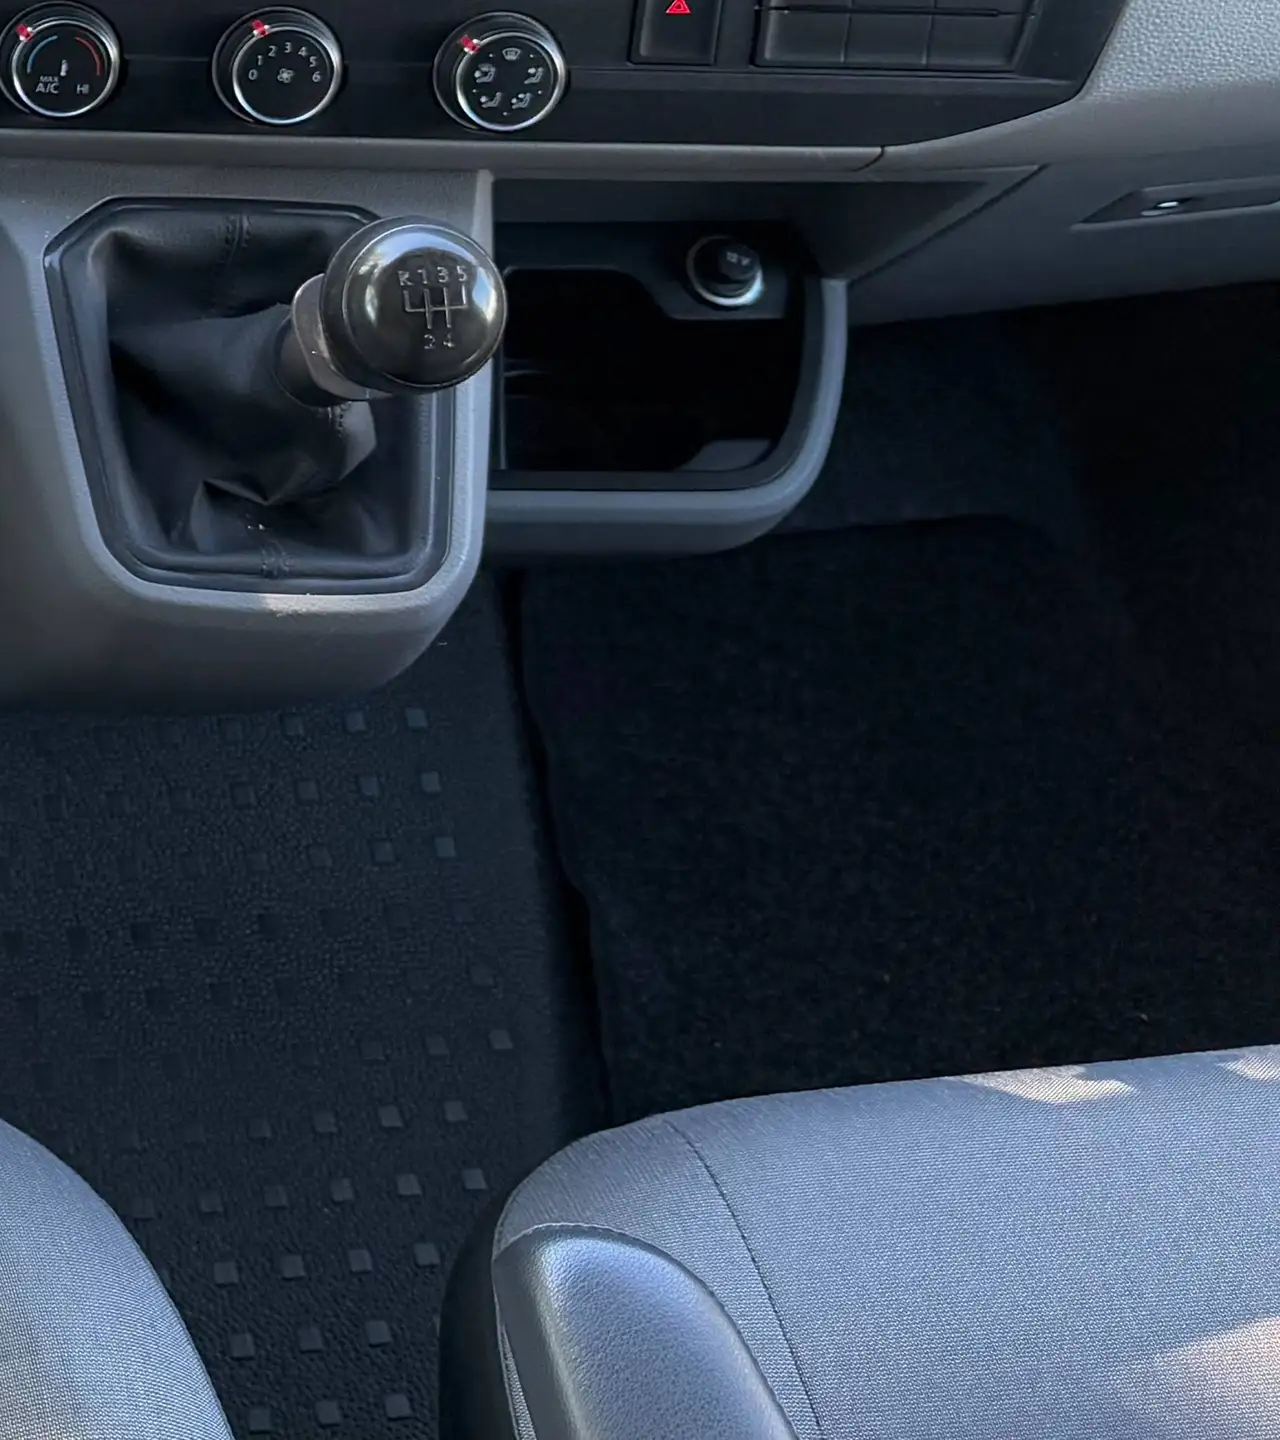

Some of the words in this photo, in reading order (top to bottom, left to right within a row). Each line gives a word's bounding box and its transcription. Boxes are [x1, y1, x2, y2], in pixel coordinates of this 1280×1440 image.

[268, 45, 277, 58] 2
[284, 42, 292, 54] 3
[298, 46, 308, 58] 4
[256, 54, 264, 66] 1
[308, 55, 317, 67] 5
[248, 69, 258, 81] 0
[311, 70, 321, 82] 6
[35, 82, 60, 94] A/C
[76, 83, 90, 95] HI
[397, 269, 414, 286] R
[417, 268, 428, 285] 1
[436, 266, 449, 283] 3
[455, 265, 468, 282] 5
[423, 334, 436, 350] 2
[443, 332, 456, 348] 4
